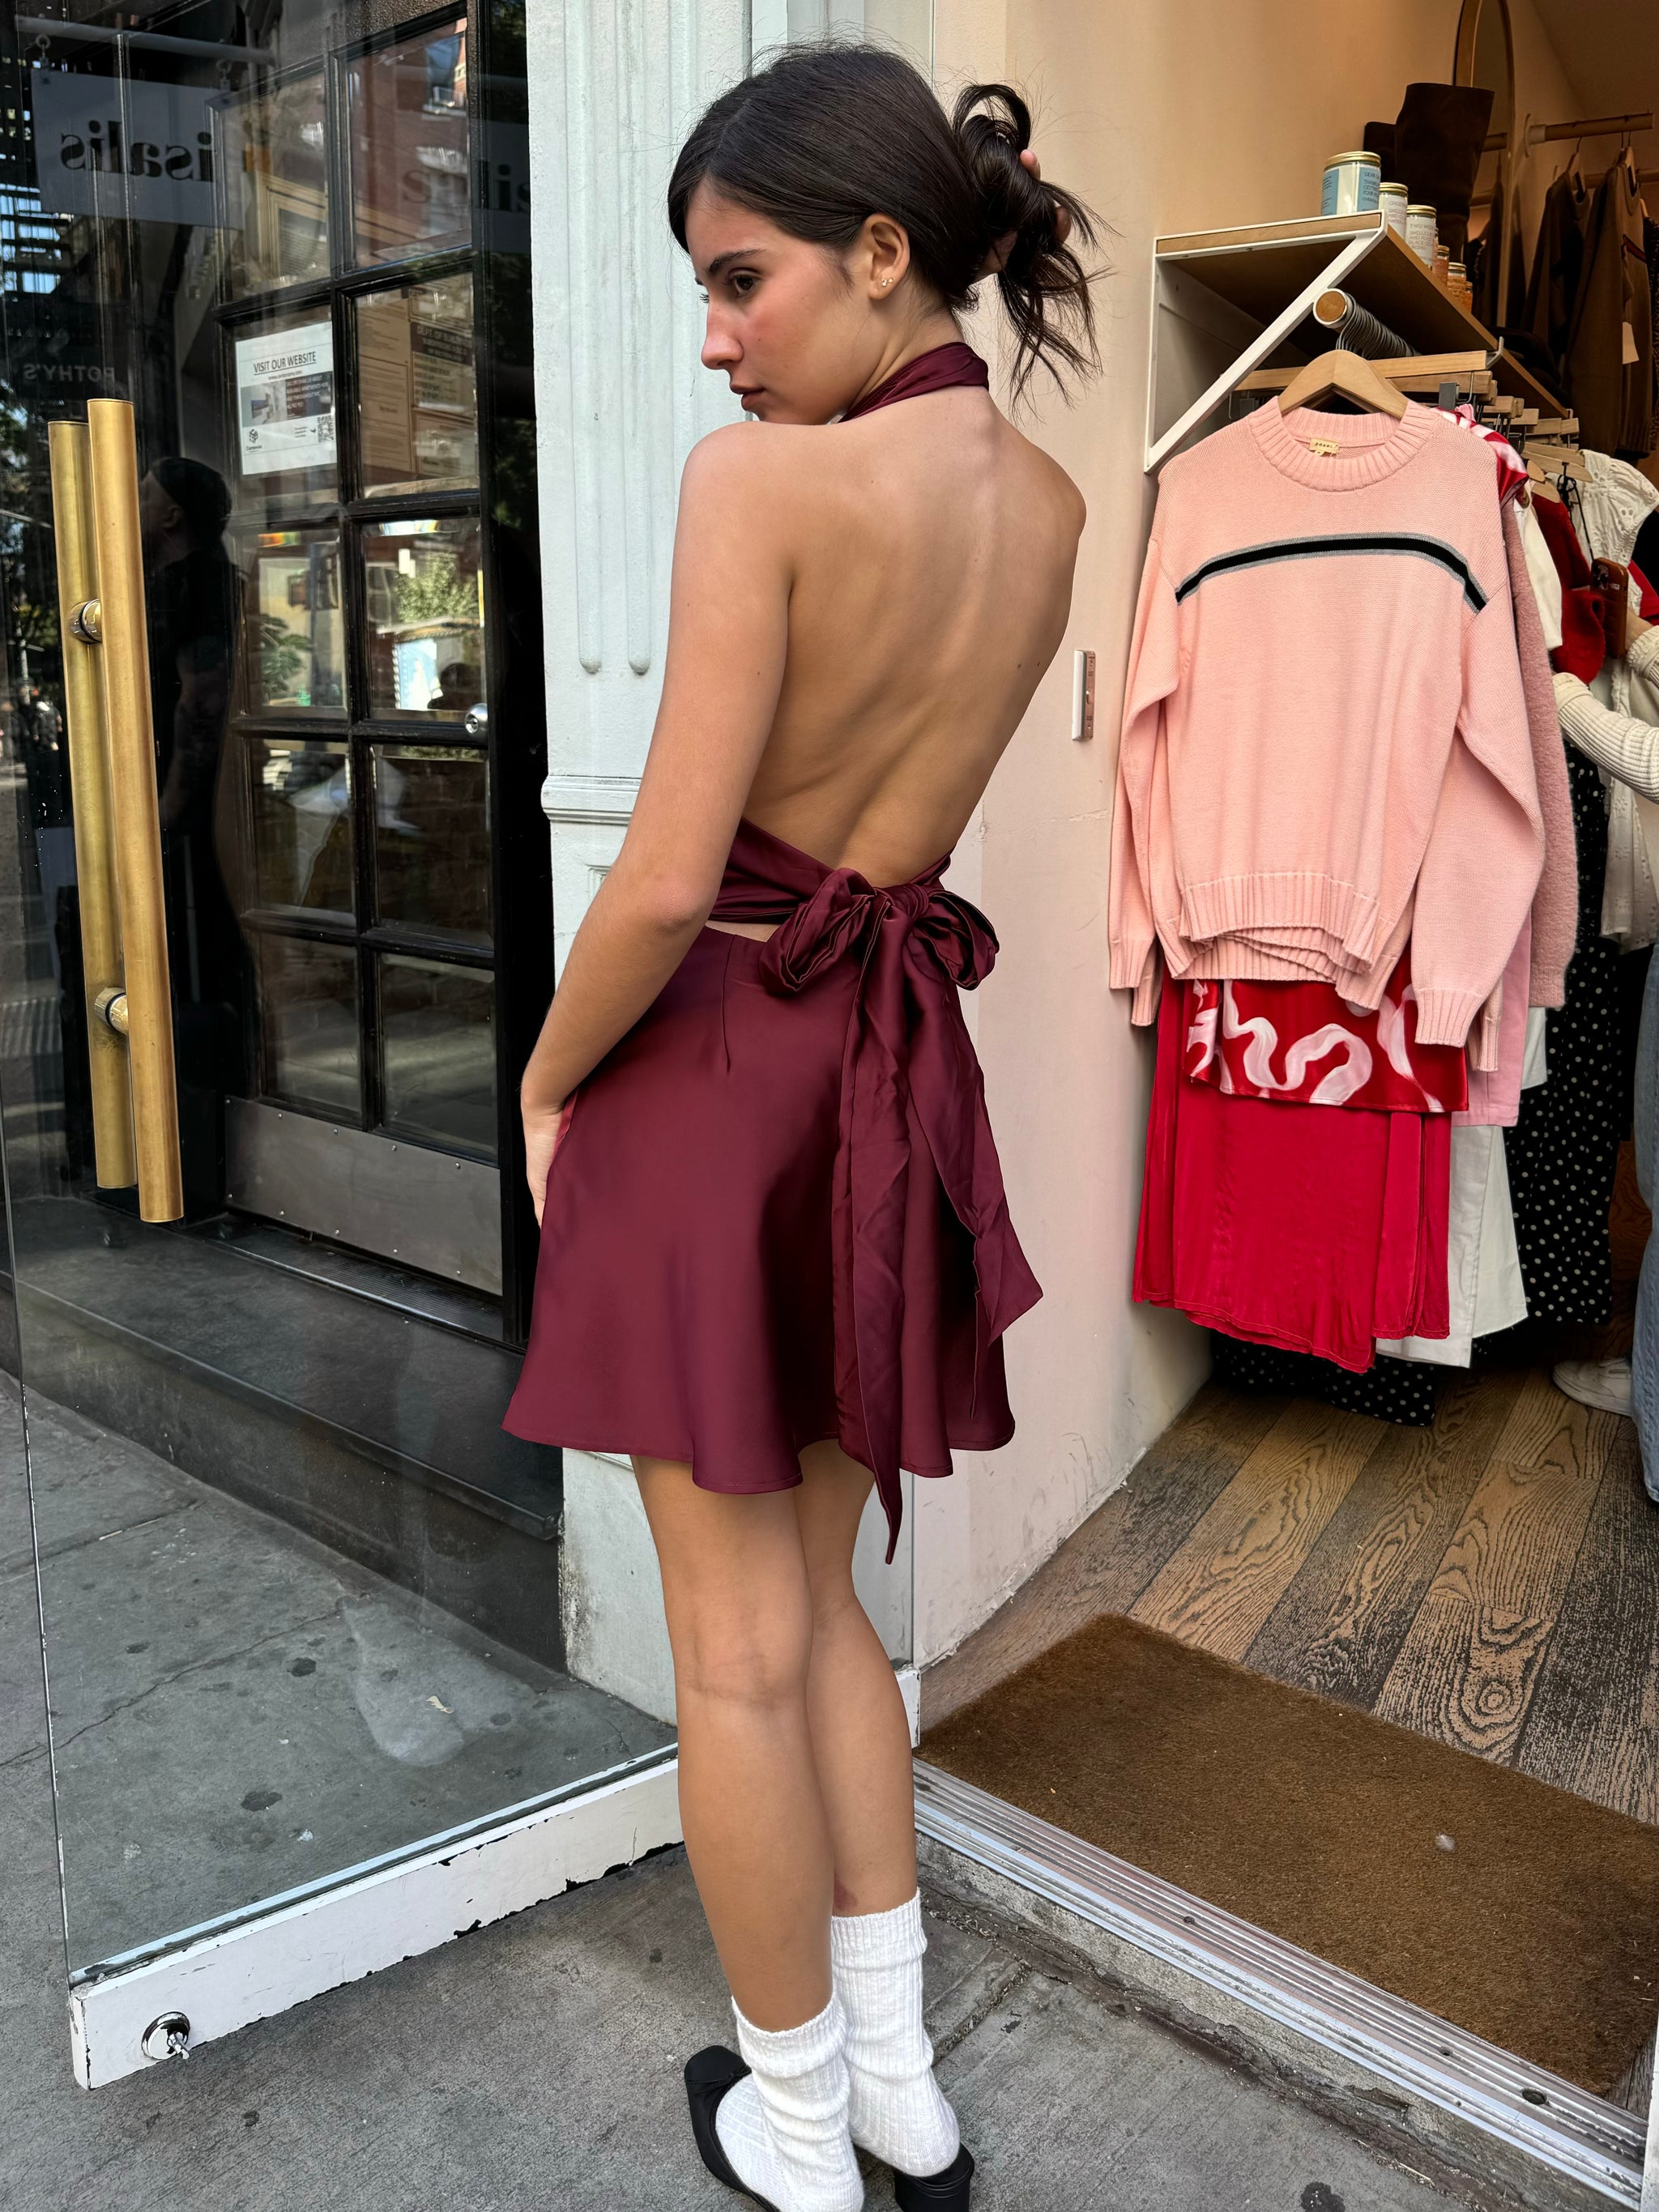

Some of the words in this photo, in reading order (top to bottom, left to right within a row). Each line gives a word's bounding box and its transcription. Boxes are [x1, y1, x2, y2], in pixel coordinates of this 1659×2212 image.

[254, 360, 270, 373] VISIT
[271, 357, 286, 369] OUR
[287, 352, 317, 366] WEBSITE
